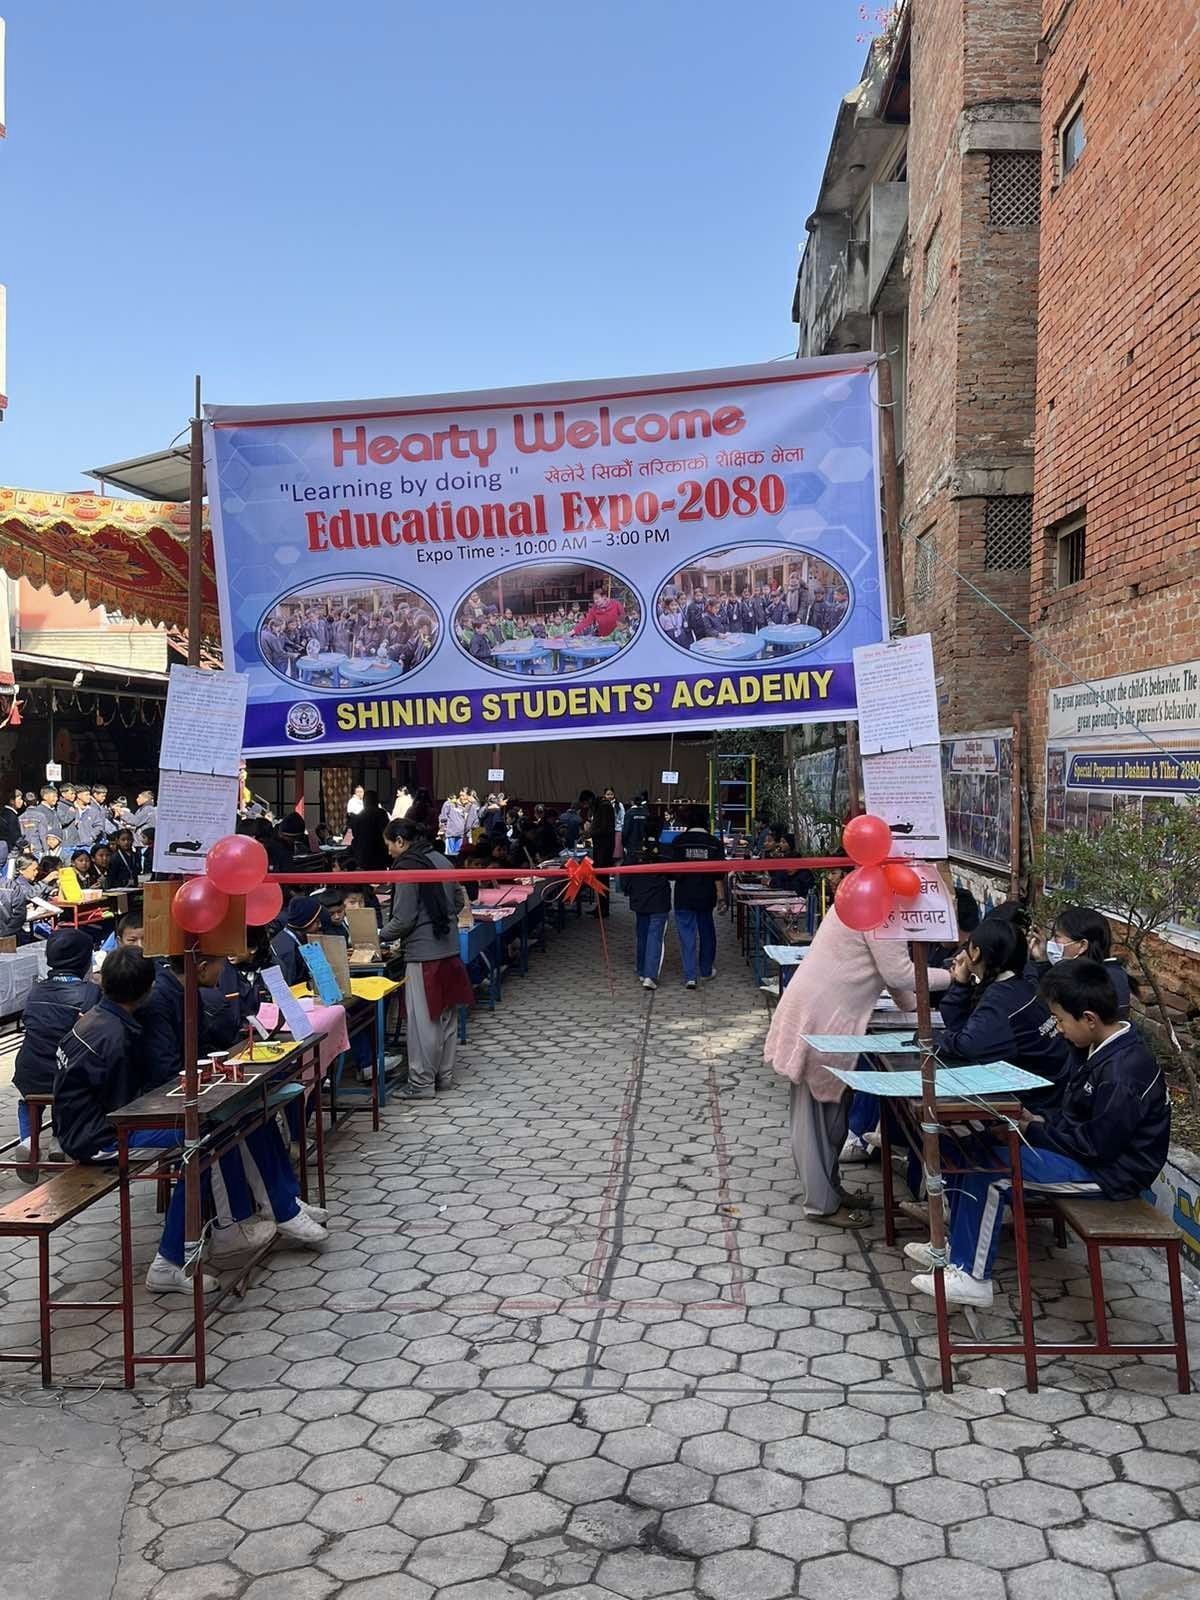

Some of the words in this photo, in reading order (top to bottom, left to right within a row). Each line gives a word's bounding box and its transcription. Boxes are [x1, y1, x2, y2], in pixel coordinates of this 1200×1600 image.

[333, 424, 497, 468] Hearty
[513, 405, 747, 453] Welcome
[280, 479, 392, 502] "Learning
[401, 475, 428, 497] by
[436, 472, 502, 492] doing
[305, 494, 549, 552] Educational
[560, 473, 786, 534] Expo-2080
[417, 547, 453, 564] Expo
[457, 545, 495, 560] Time
[515, 539, 557, 555] 10:00
[561, 535, 588, 551] AM
[606, 531, 640, 547] 3:00
[645, 528, 670, 544] PM
[336, 696, 472, 730] SHINING
[482, 682, 661, 721] STUDENTS'
[671, 670, 834, 709] ACADEMY
[1117, 682, 1127, 701] the
[1128, 676, 1148, 699] child's
[1183, 670, 1198, 691] The
[1136, 701, 1163, 727] parent's
[1164, 697, 1197, 720] behavior
[1074, 761, 1092, 782] Special
[1093, 761, 1116, 782] Program
[1117, 761, 1123, 778] in
[1124, 761, 1150, 778] Dashain
[1151, 761, 1158, 779] &
[1160, 761, 1179, 779] Tihar
